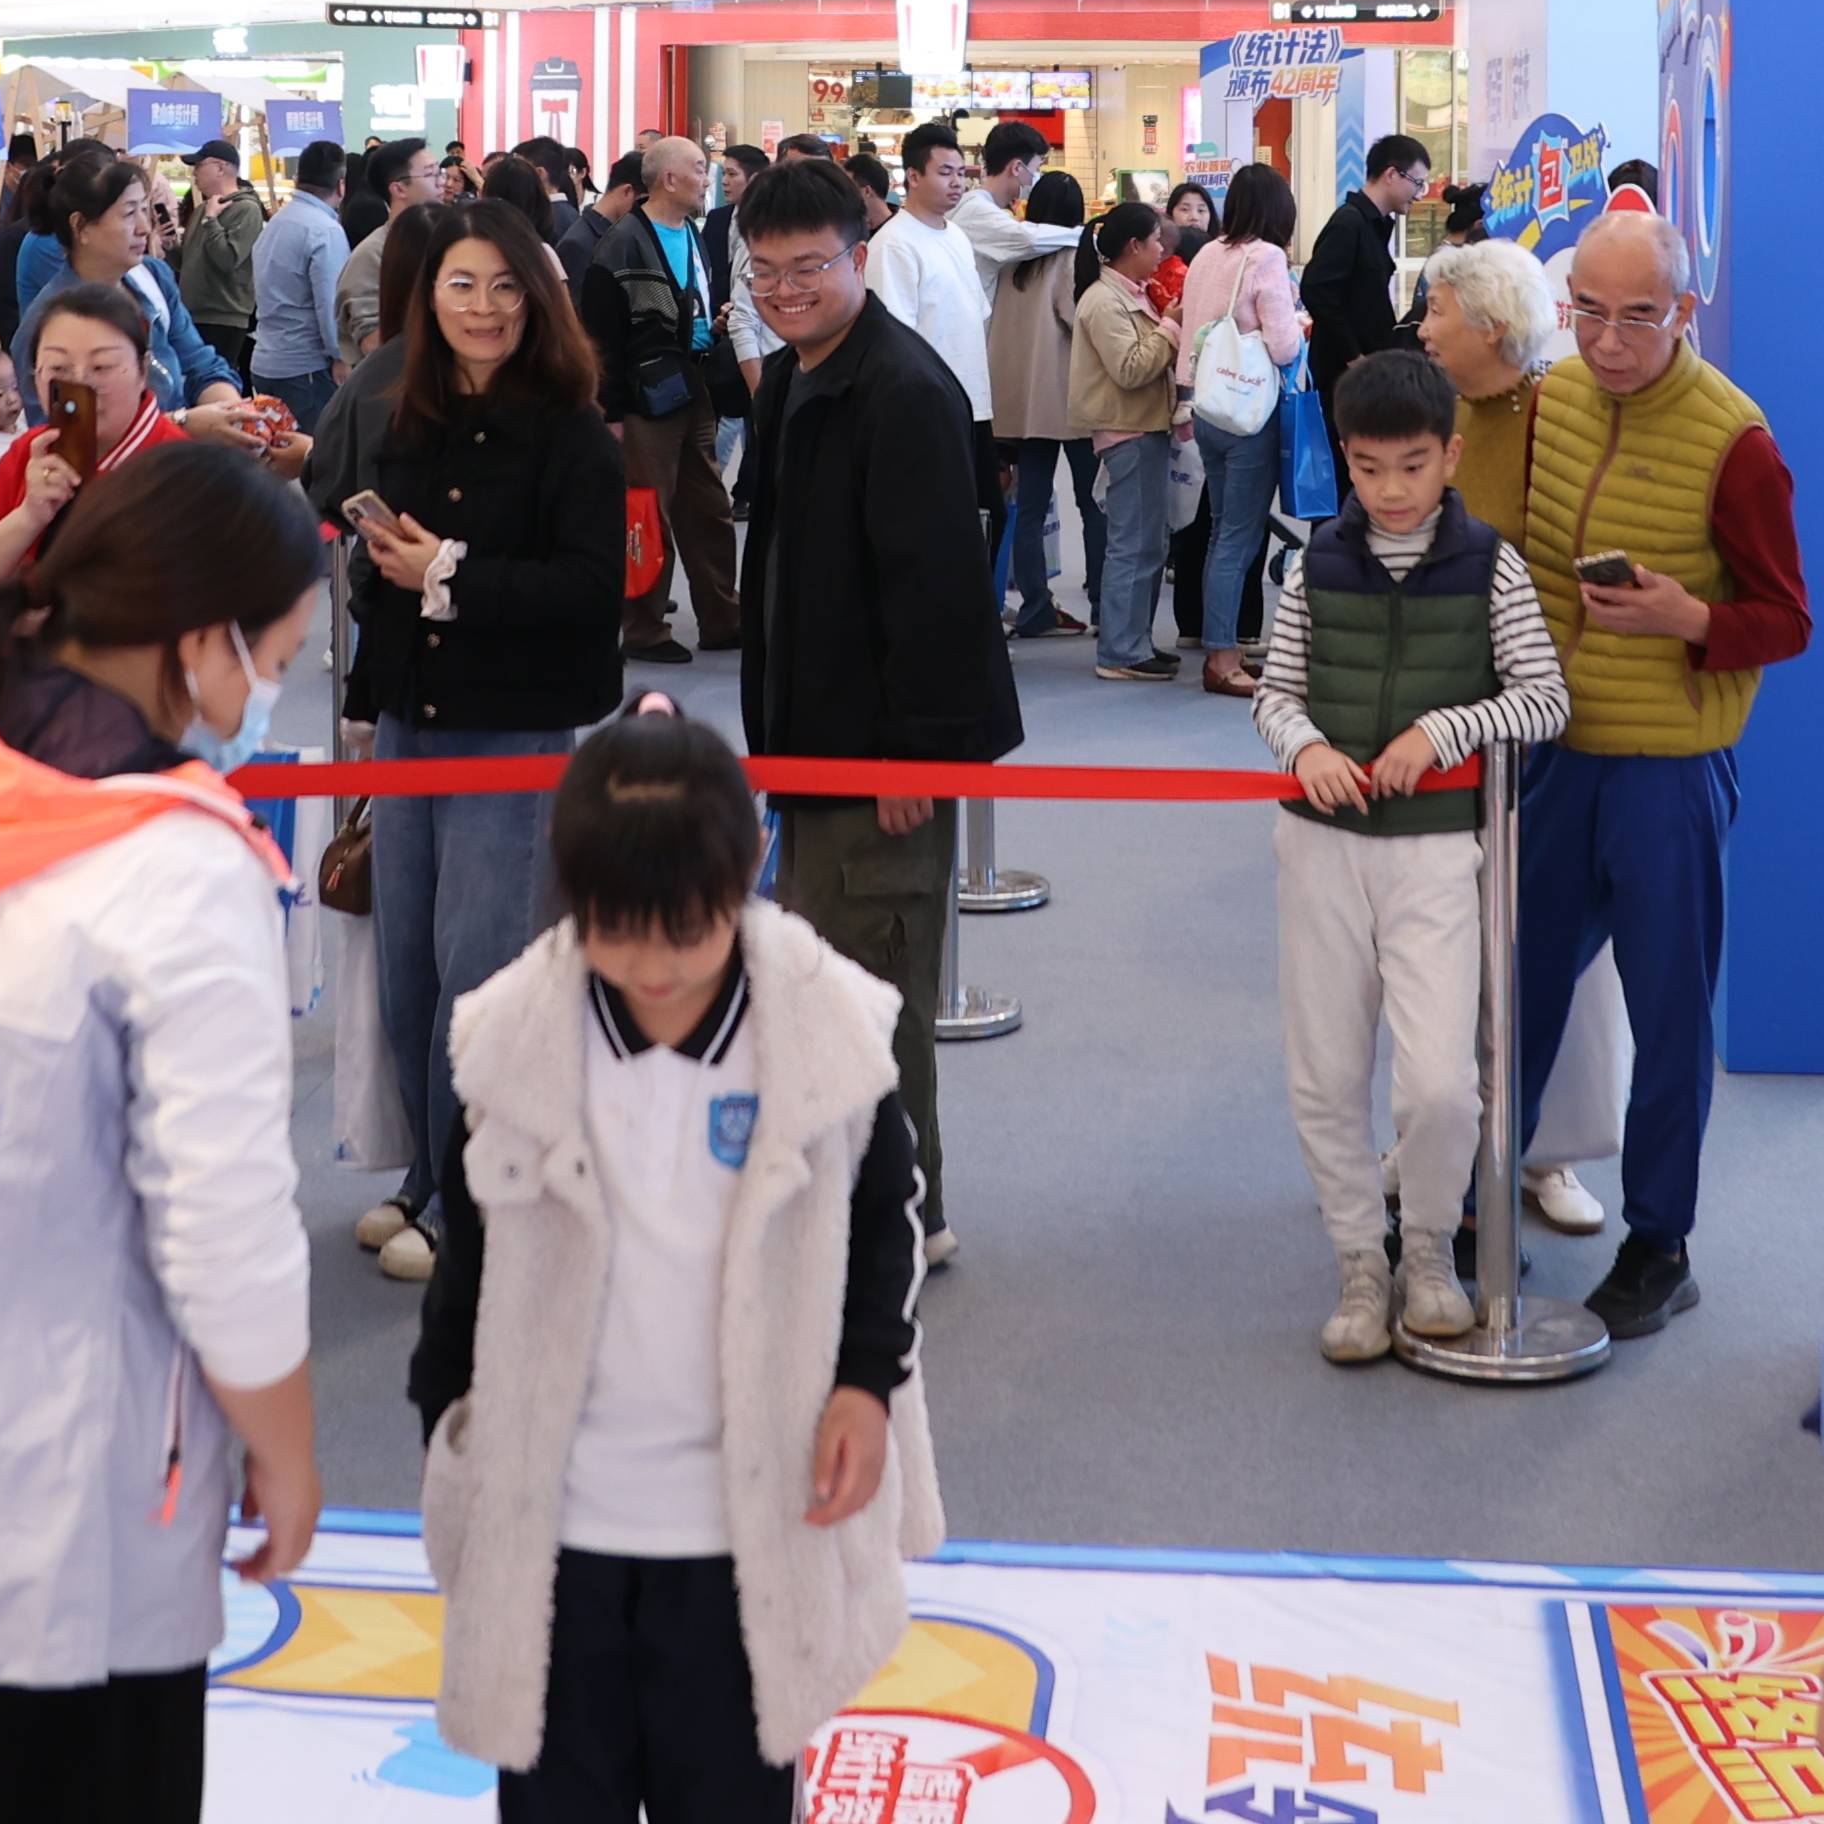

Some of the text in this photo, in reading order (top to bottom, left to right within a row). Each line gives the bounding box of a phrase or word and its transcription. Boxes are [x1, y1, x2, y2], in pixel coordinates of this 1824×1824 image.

[1229, 28, 1342, 68] 《统计法》
[1226, 67, 1341, 99] 颁布42周年
